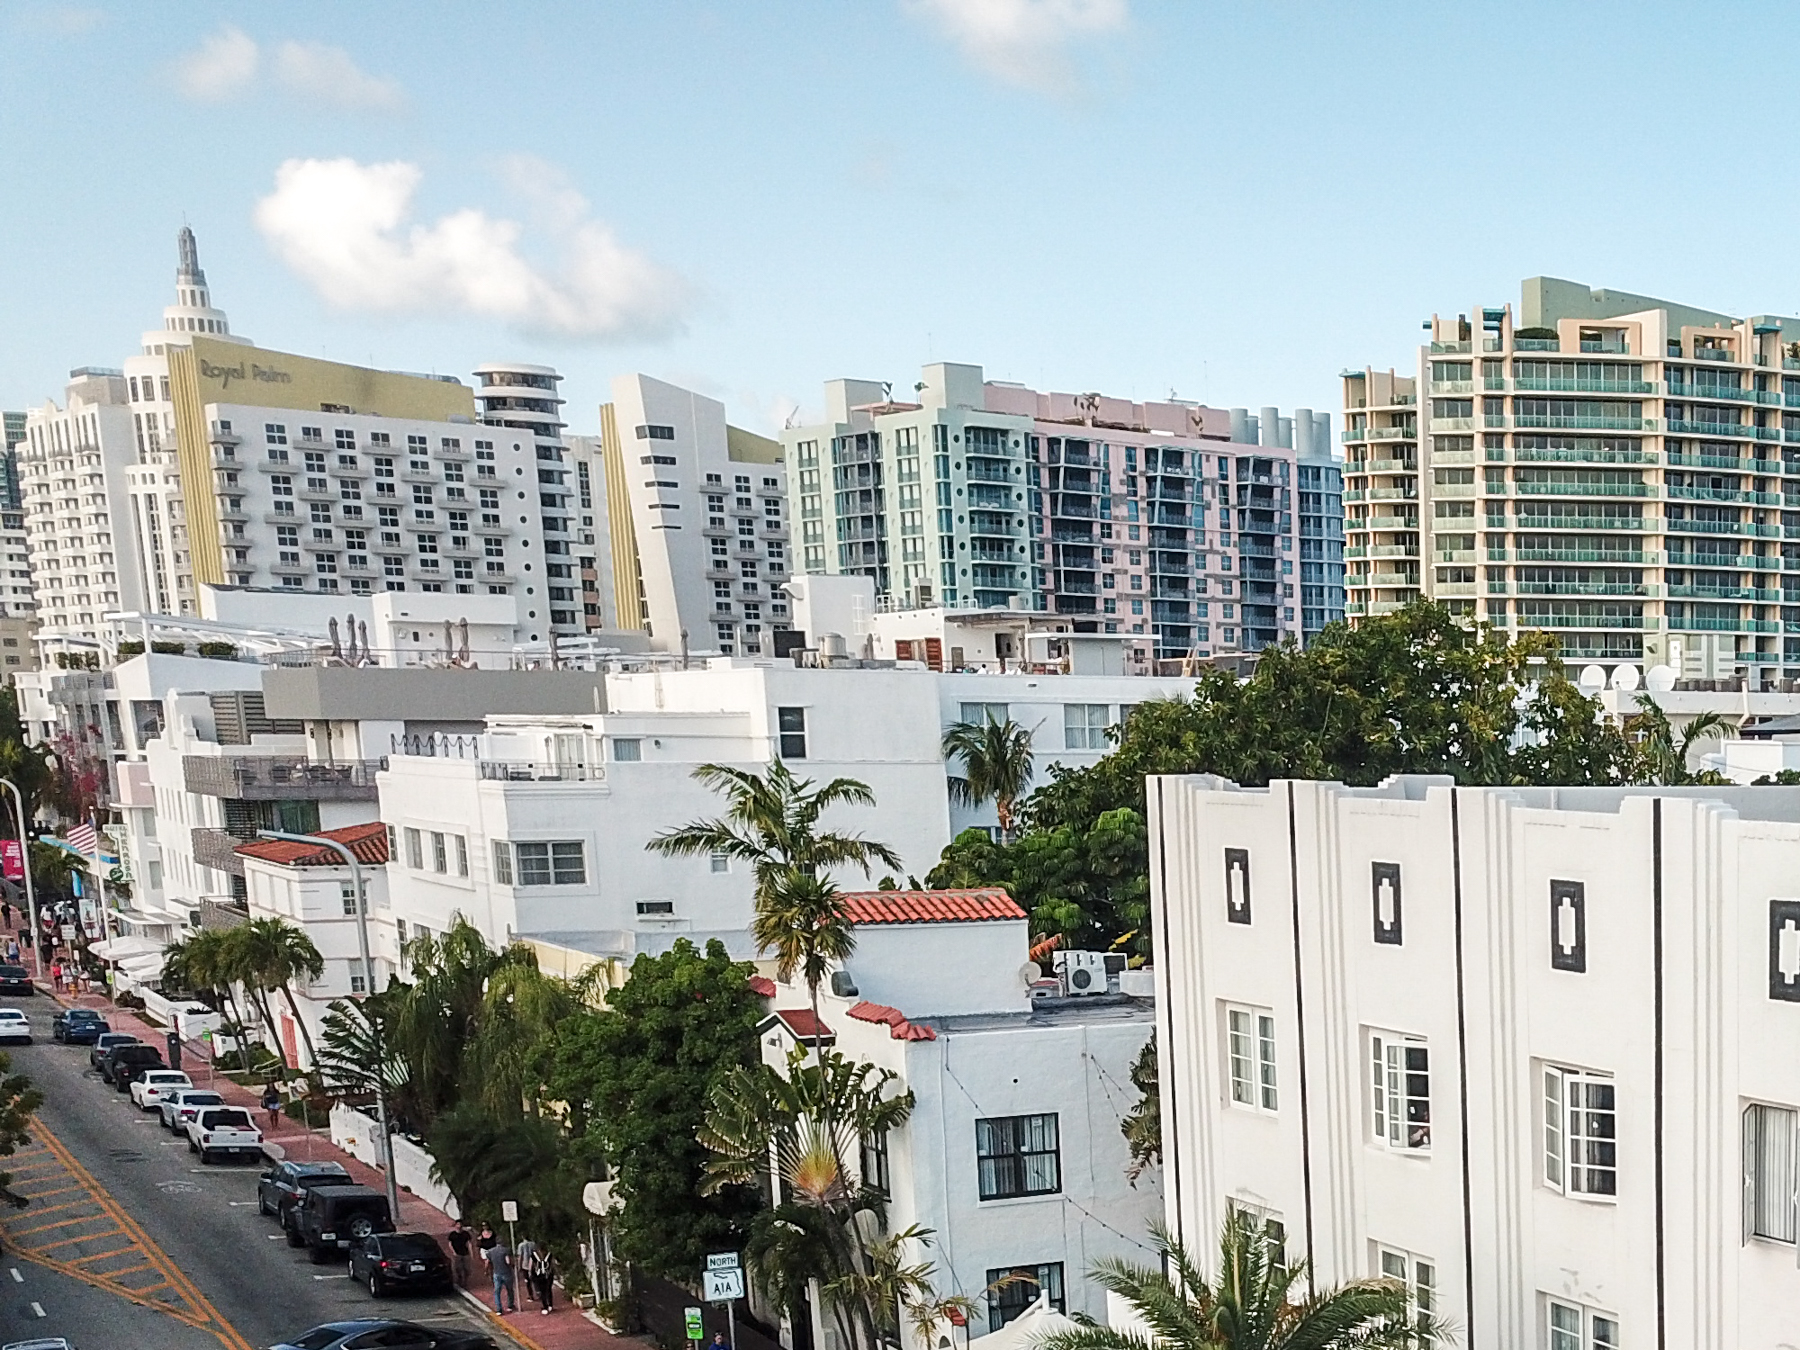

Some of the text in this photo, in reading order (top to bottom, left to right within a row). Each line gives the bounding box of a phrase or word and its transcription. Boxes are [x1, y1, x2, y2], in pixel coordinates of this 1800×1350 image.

[200, 359, 292, 390] Royal Palm
[709, 1256, 736, 1267] NORTH
[713, 1281, 733, 1296] A1A
